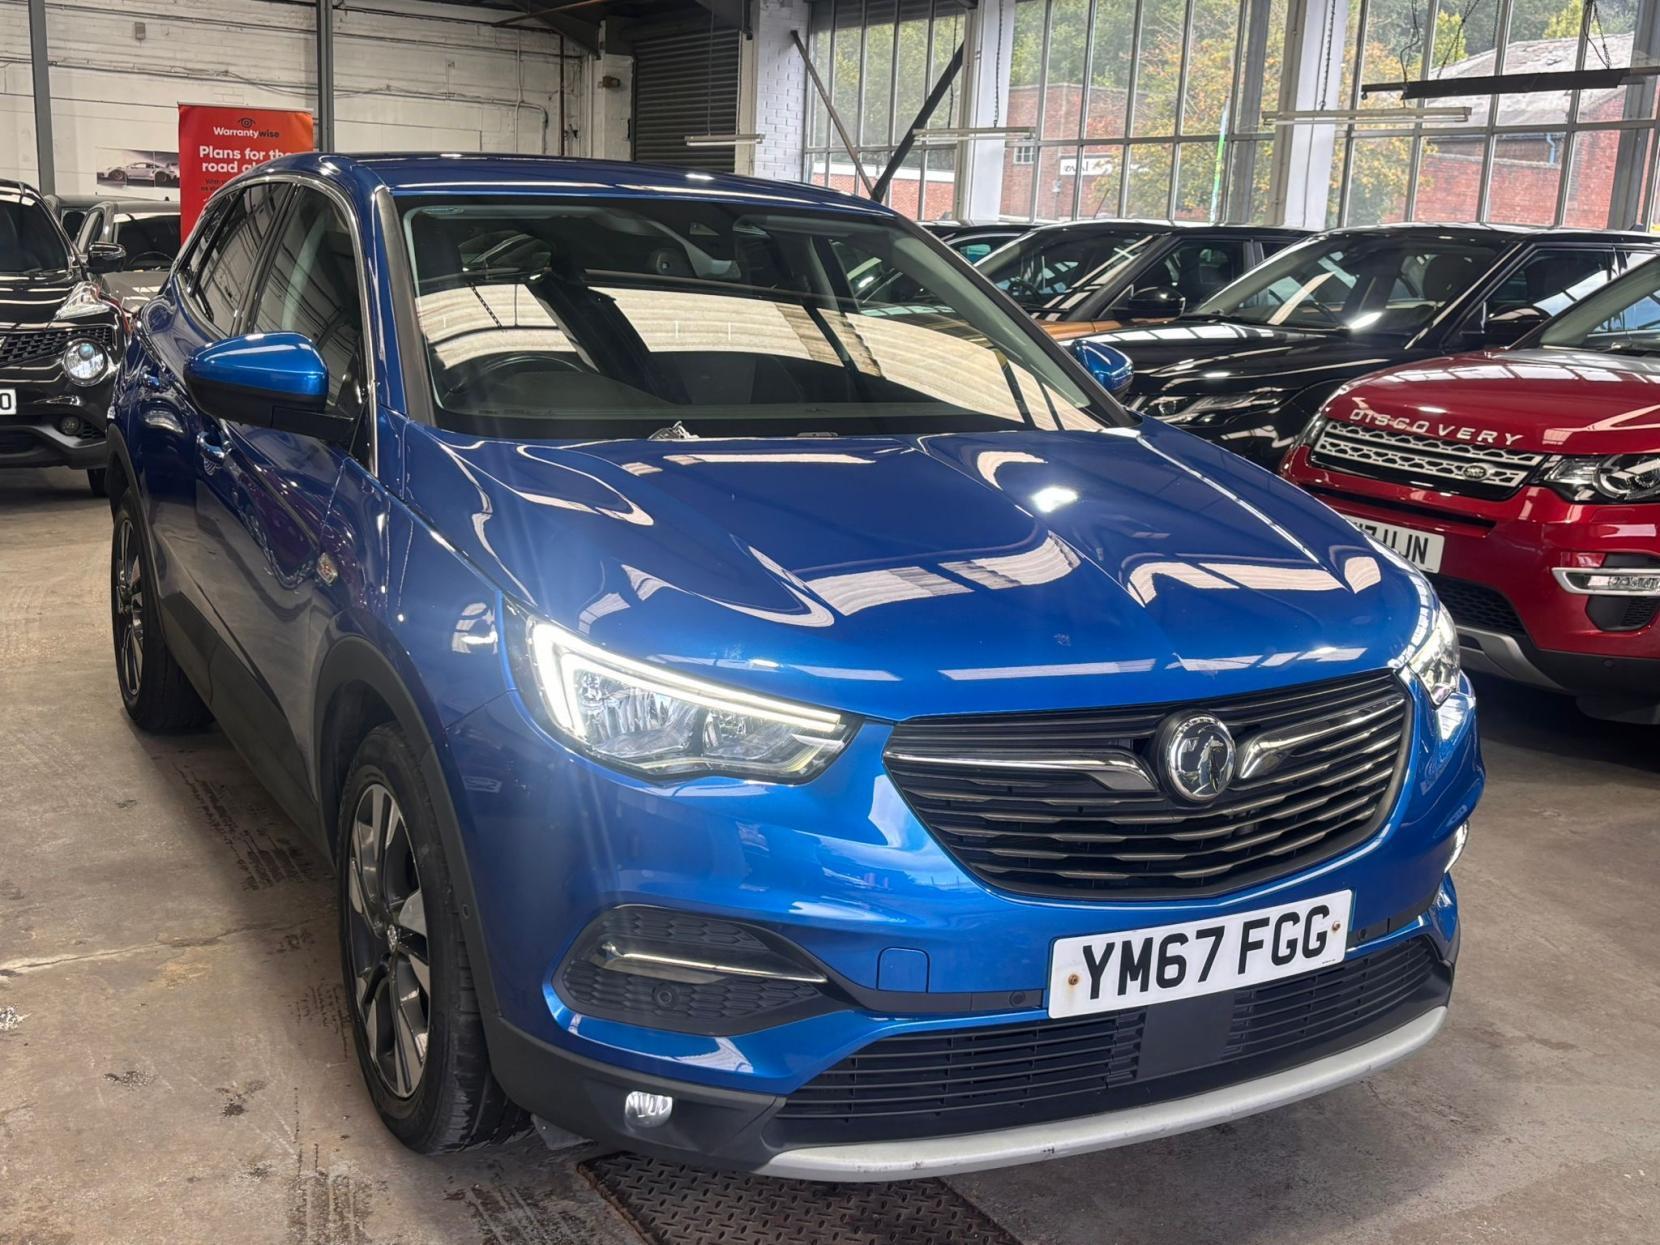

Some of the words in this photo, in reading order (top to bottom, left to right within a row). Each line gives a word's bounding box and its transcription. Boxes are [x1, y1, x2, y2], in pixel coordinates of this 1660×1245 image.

[213, 127, 280, 138] Warrantywise
[200, 145, 241, 159] Plans
[244, 147, 266, 160] for
[202, 161, 238, 173] road
[1350, 409, 1525, 446] DISCOVERY
[1082, 925, 1225, 1000] YM67
[1238, 904, 1330, 975] FGG
